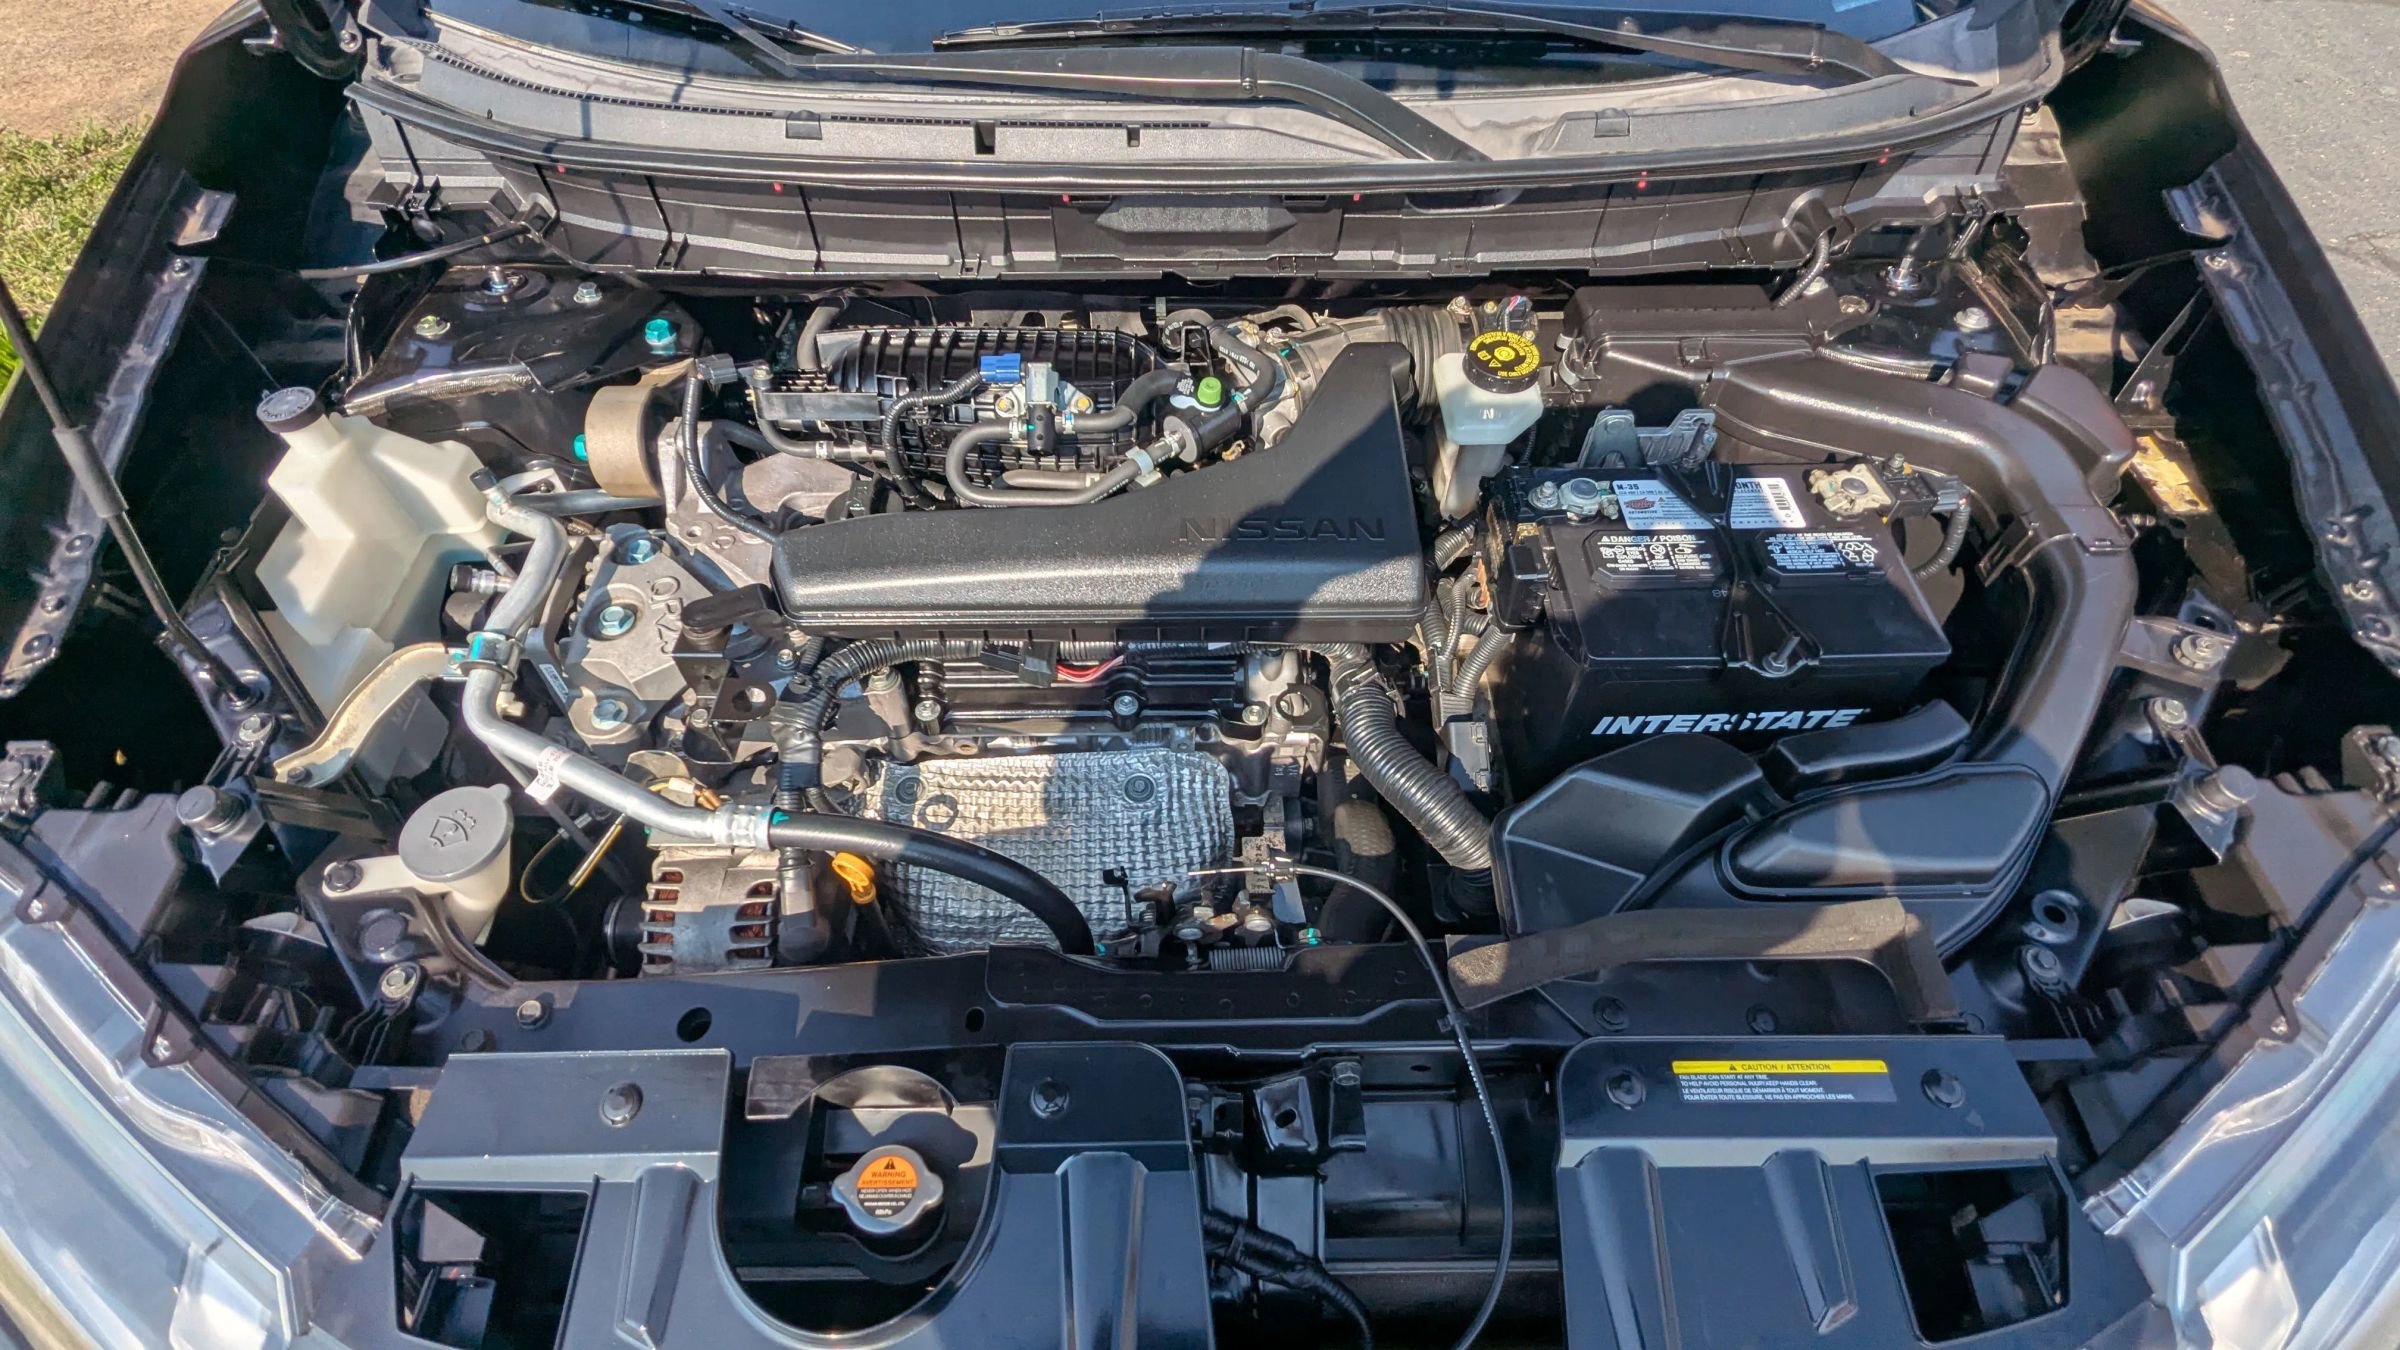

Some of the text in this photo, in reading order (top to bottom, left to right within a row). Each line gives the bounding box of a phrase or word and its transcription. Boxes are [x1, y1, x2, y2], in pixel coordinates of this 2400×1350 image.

[1179, 517, 1385, 541] NISSAN
[1659, 534, 1696, 542] POISON
[1590, 708, 1864, 735] INTERSTATE
[1787, 1063, 1832, 1071] ATTENTION
